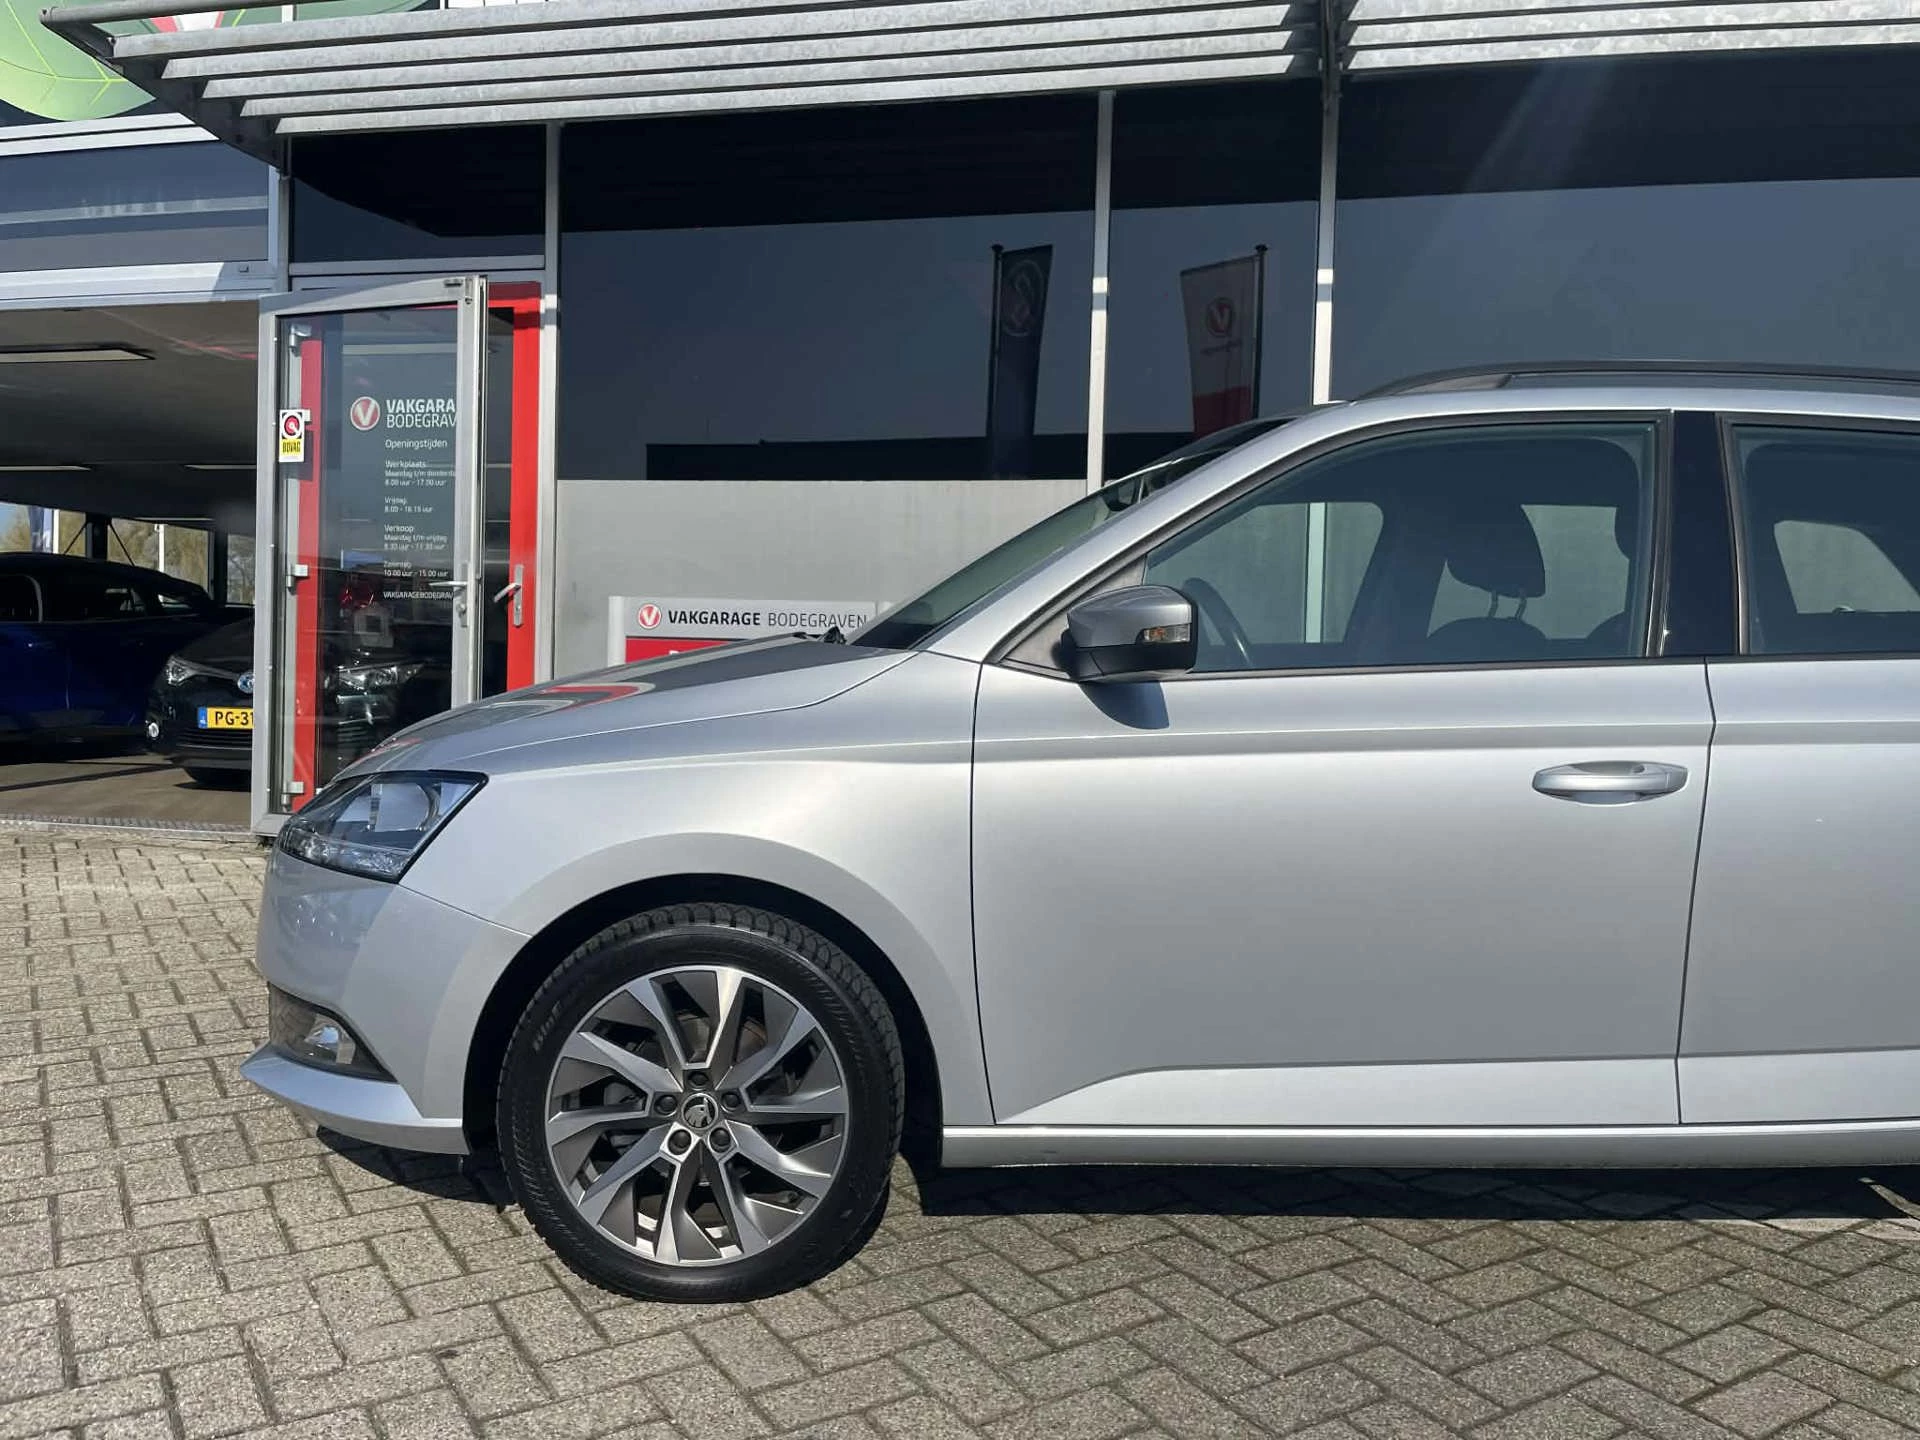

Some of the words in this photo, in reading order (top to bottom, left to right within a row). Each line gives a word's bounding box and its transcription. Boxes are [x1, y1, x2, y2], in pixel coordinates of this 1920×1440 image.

[386, 398, 455, 413] VAKGARA
[386, 413, 456, 428] BODEGRAV
[282, 441, 301, 453] BOVAG
[384, 439, 448, 450] Openingstijden
[668, 610, 761, 626] VAKGARAGE
[768, 612, 867, 628] BODEGRAVEN
